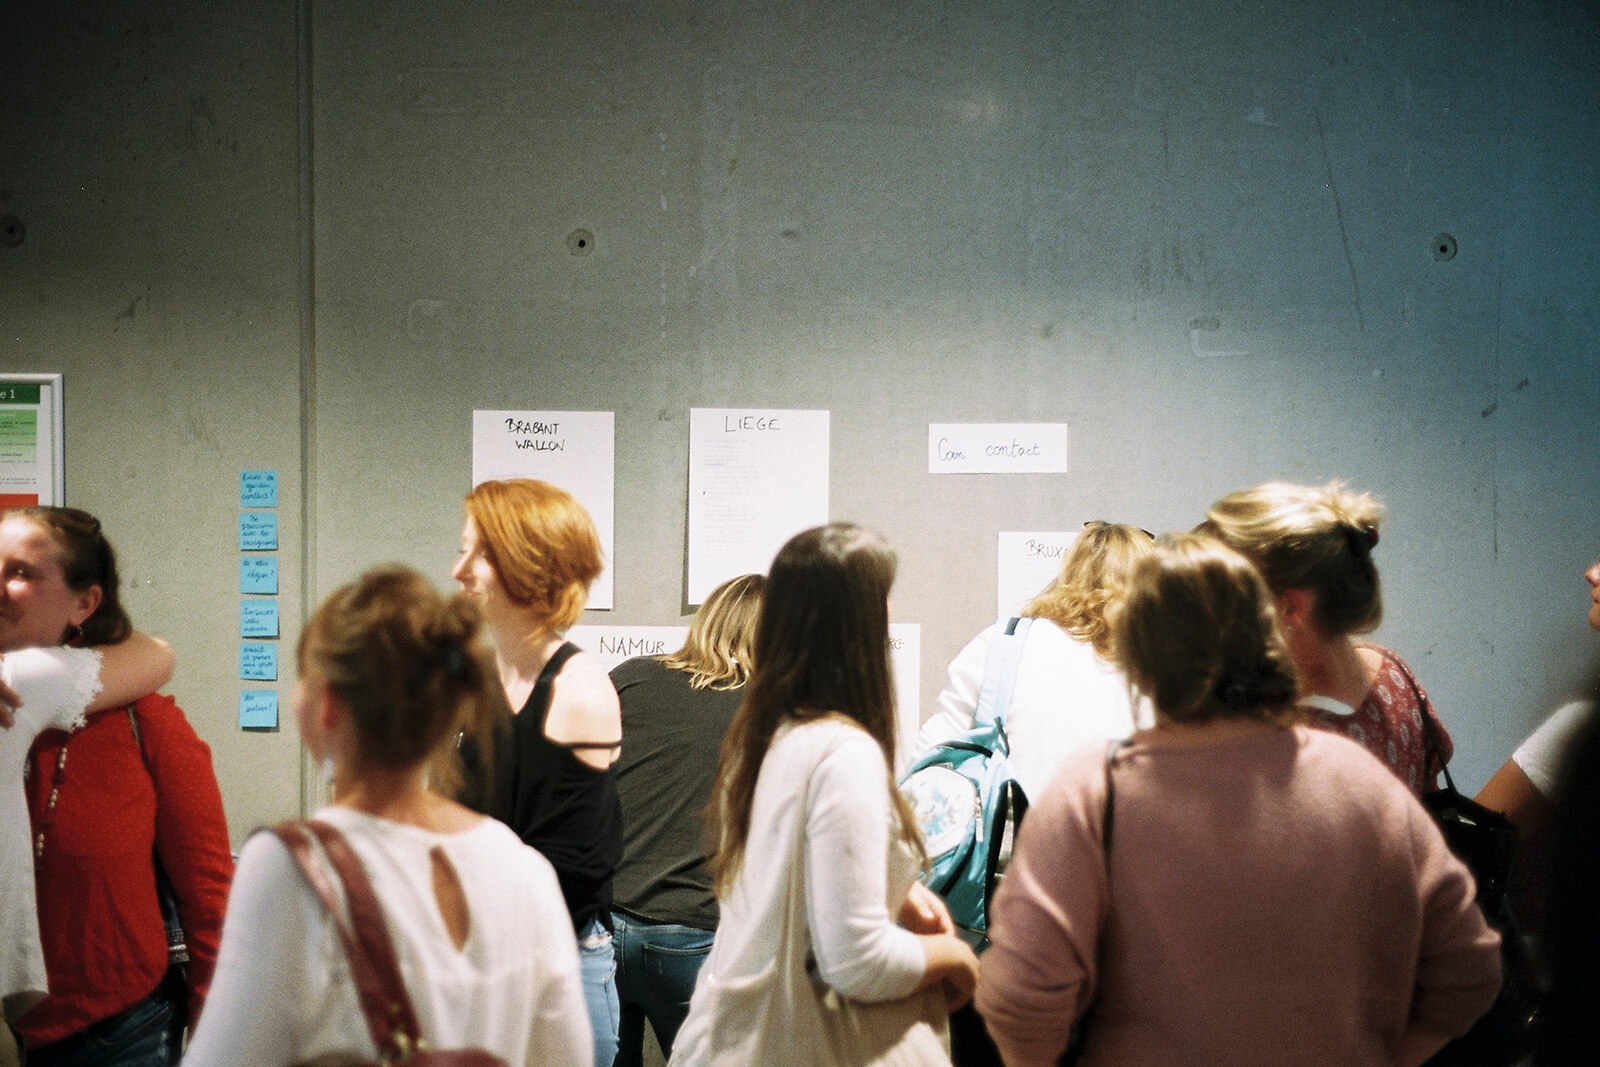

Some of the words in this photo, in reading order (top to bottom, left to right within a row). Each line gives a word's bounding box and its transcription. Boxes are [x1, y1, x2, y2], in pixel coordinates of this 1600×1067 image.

[10, 389, 15, 399] 1
[505, 418, 560, 434] BRABANT
[725, 416, 780, 432] LIEGE
[515, 439, 566, 451] WALLON
[985, 438, 1041, 457] contact
[600, 636, 665, 656] NAMUR
